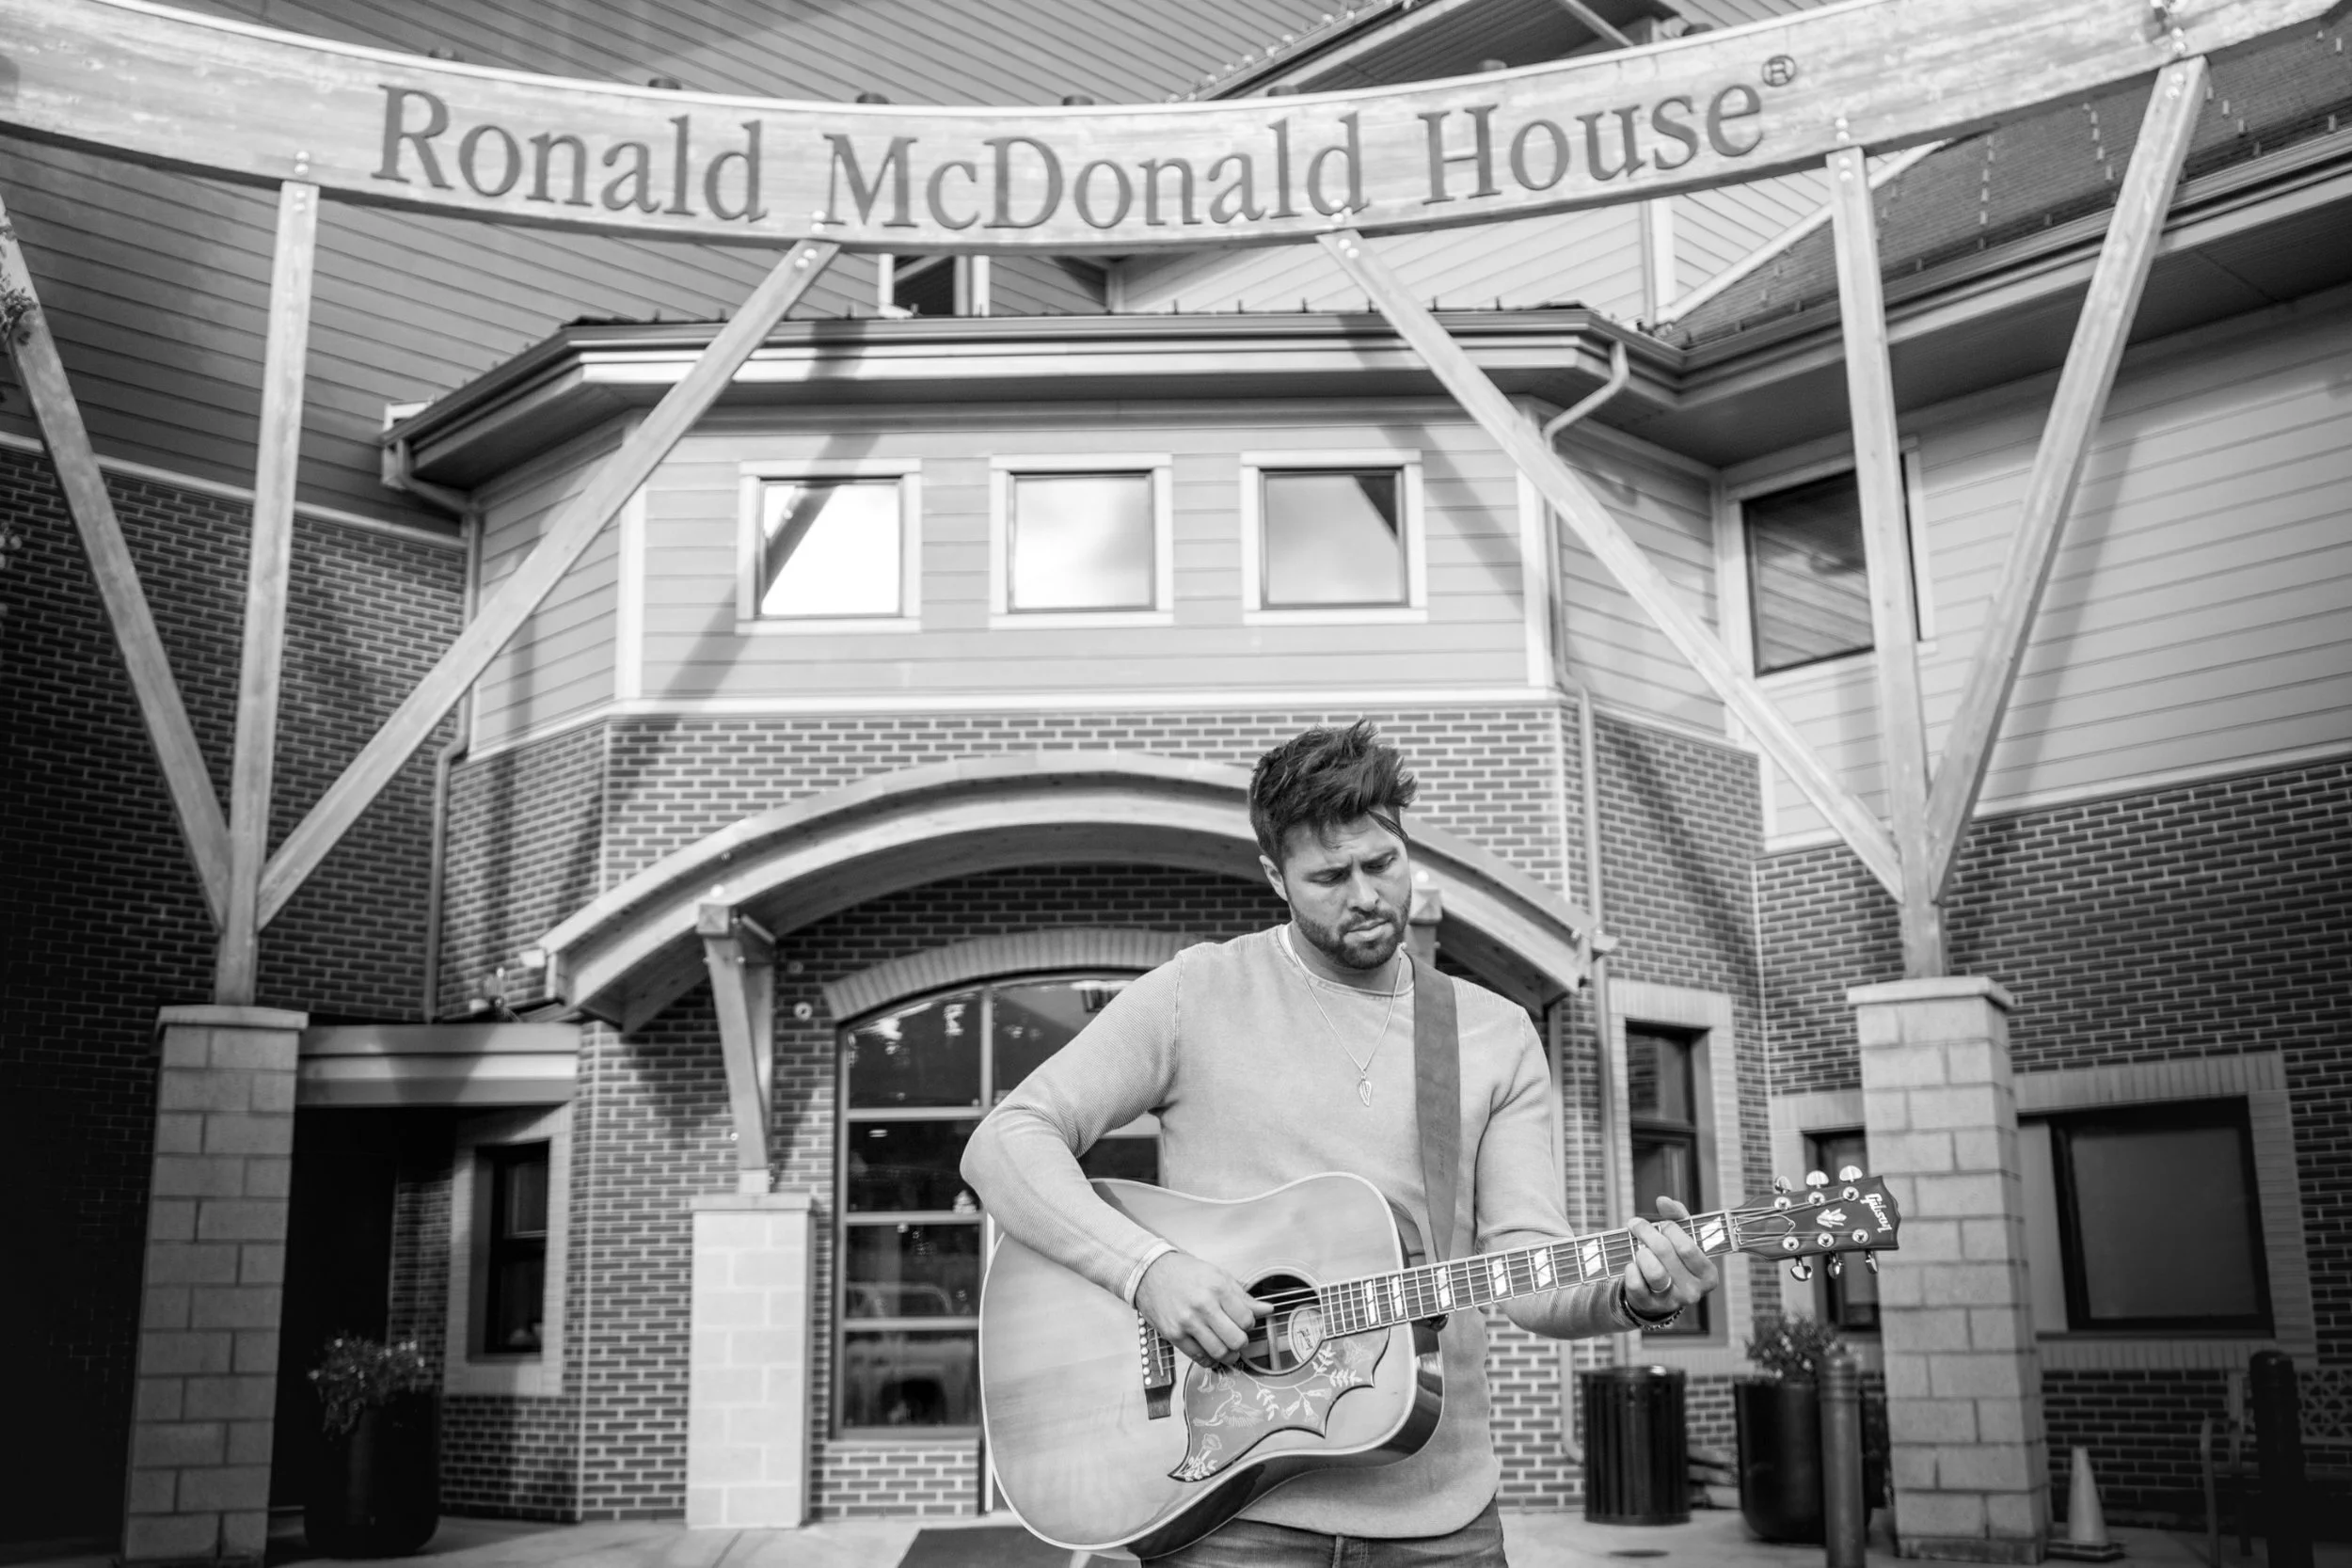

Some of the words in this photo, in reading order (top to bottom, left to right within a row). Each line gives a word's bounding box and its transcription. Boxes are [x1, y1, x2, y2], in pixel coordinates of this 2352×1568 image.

[371, 84, 768, 223] Ronald
[822, 111, 1370, 230] McDonald
[1860, 1193, 1892, 1233] Gibson
